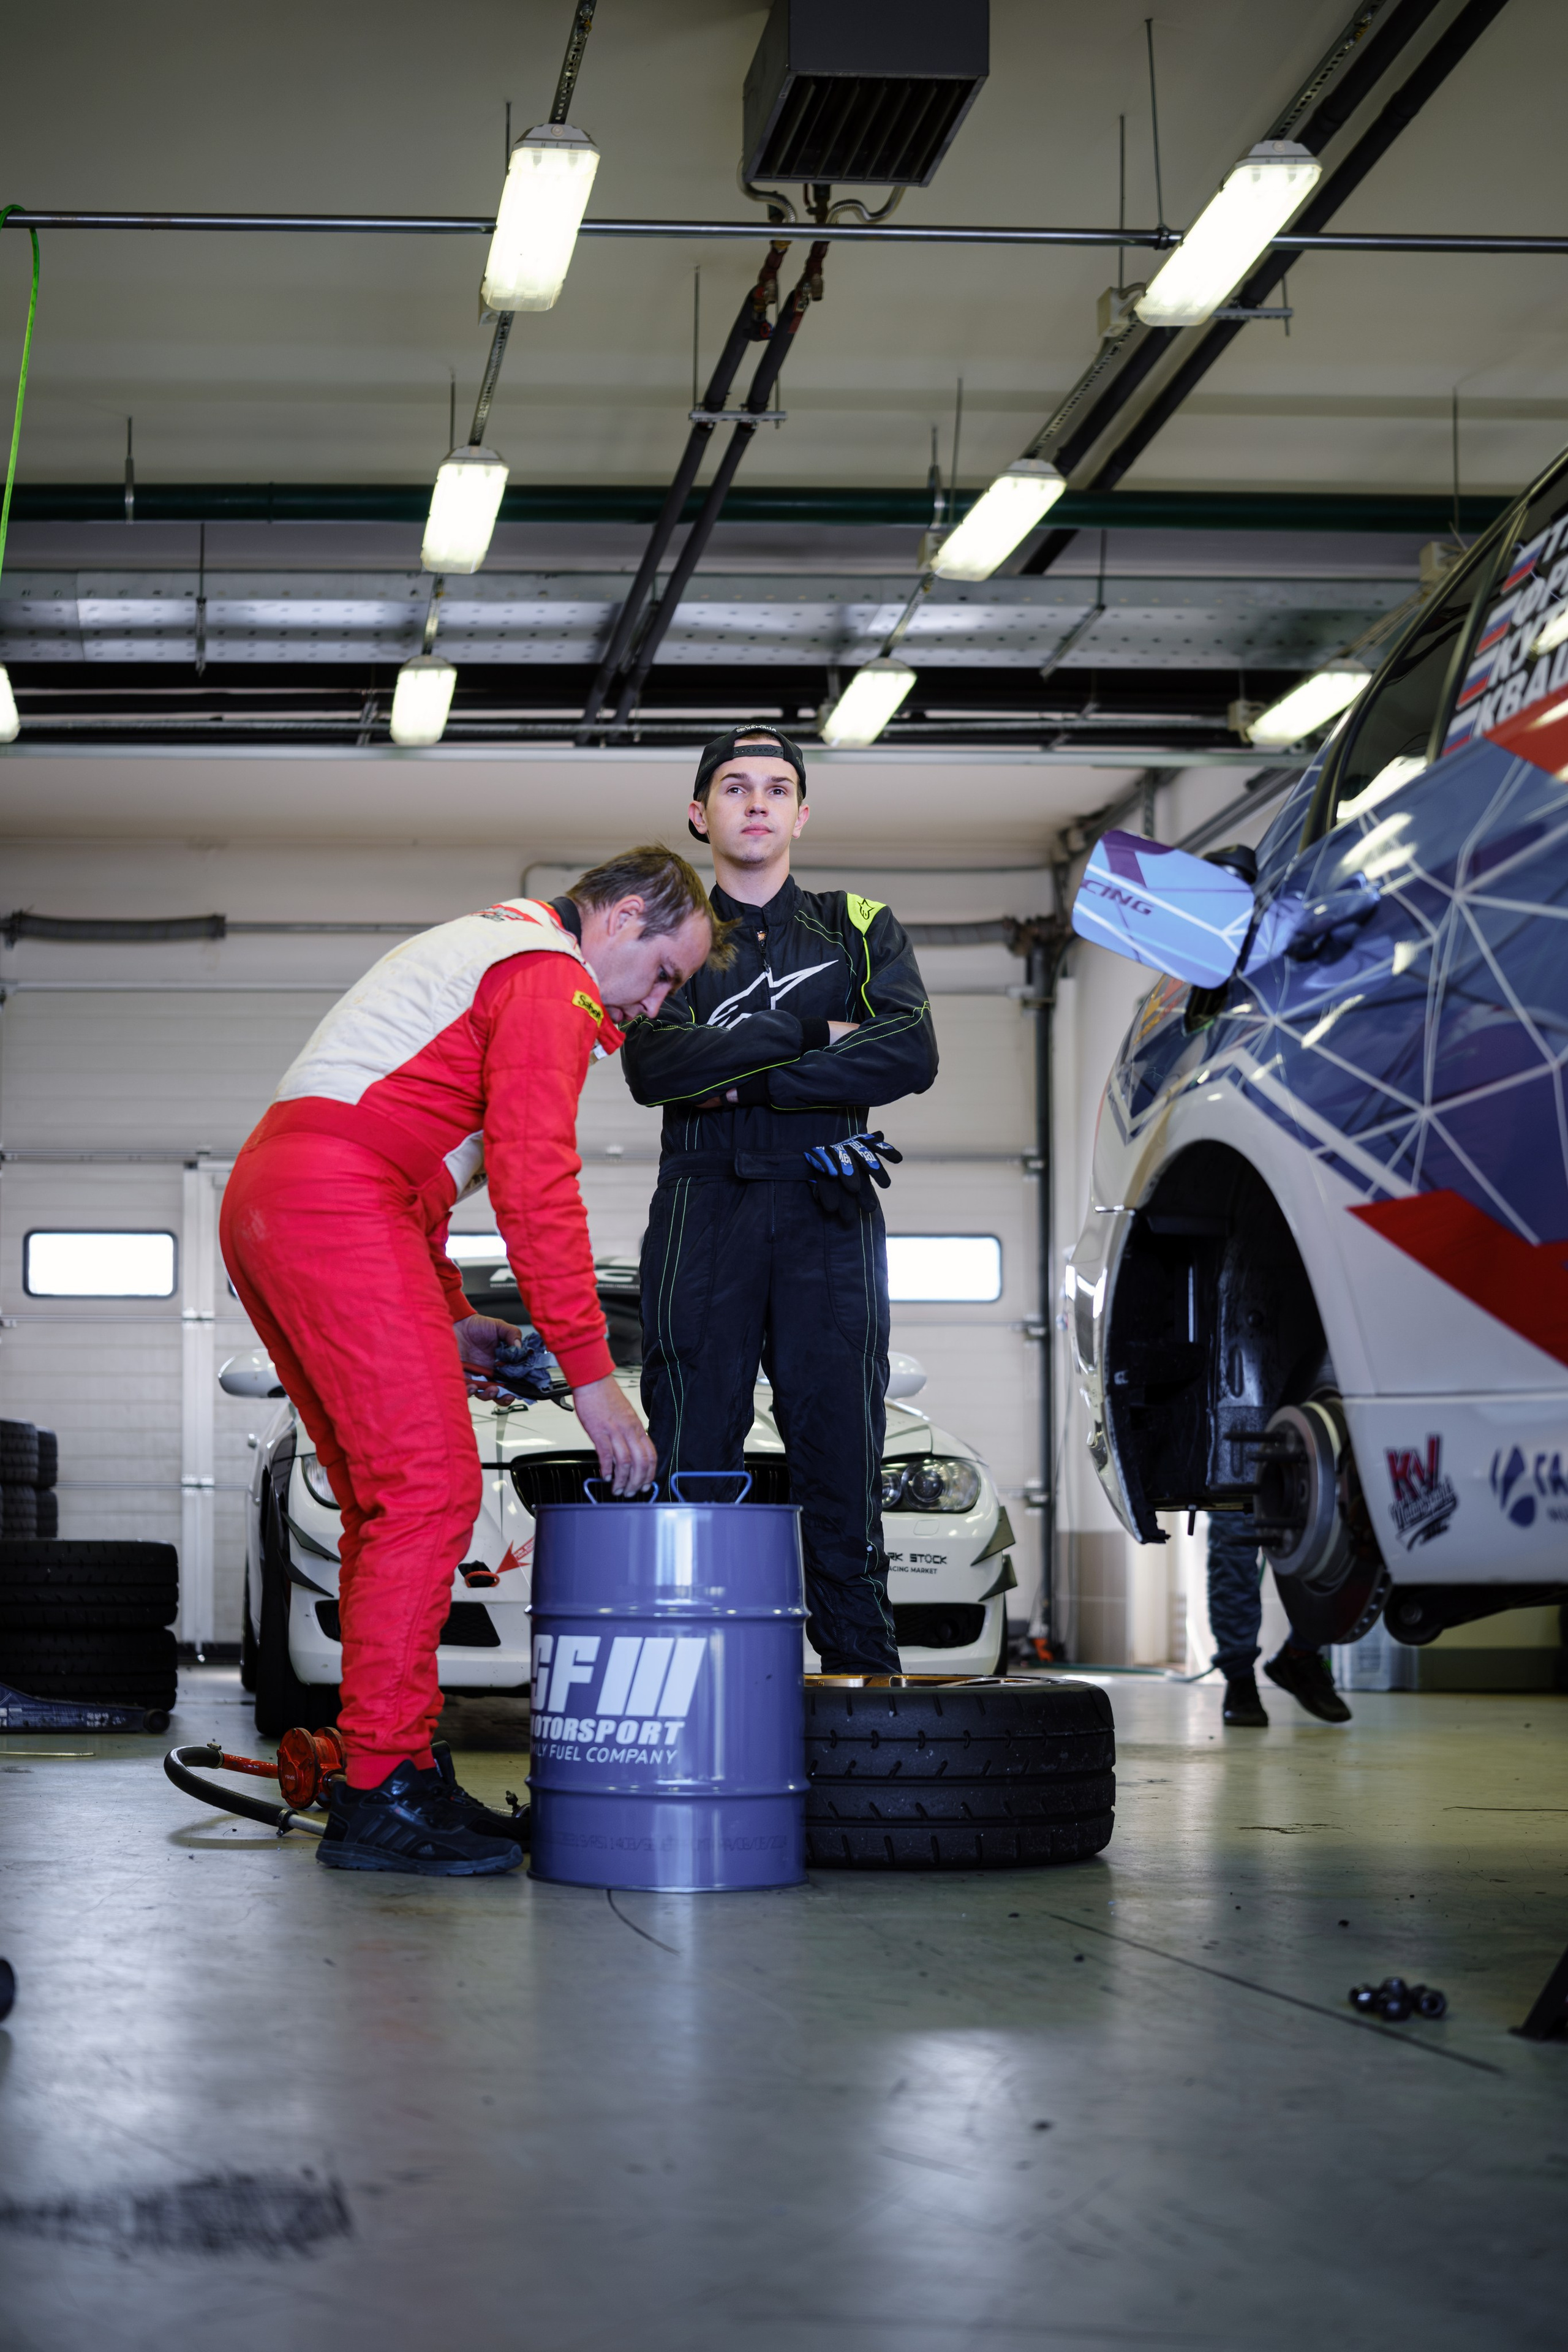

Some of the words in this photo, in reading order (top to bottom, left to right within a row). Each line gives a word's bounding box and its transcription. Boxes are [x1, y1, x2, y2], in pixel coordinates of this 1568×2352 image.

[910, 1553, 947, 1564] STOCK
[549, 1744, 581, 1762] FUEL
[586, 1746, 678, 1765] COMPANY
